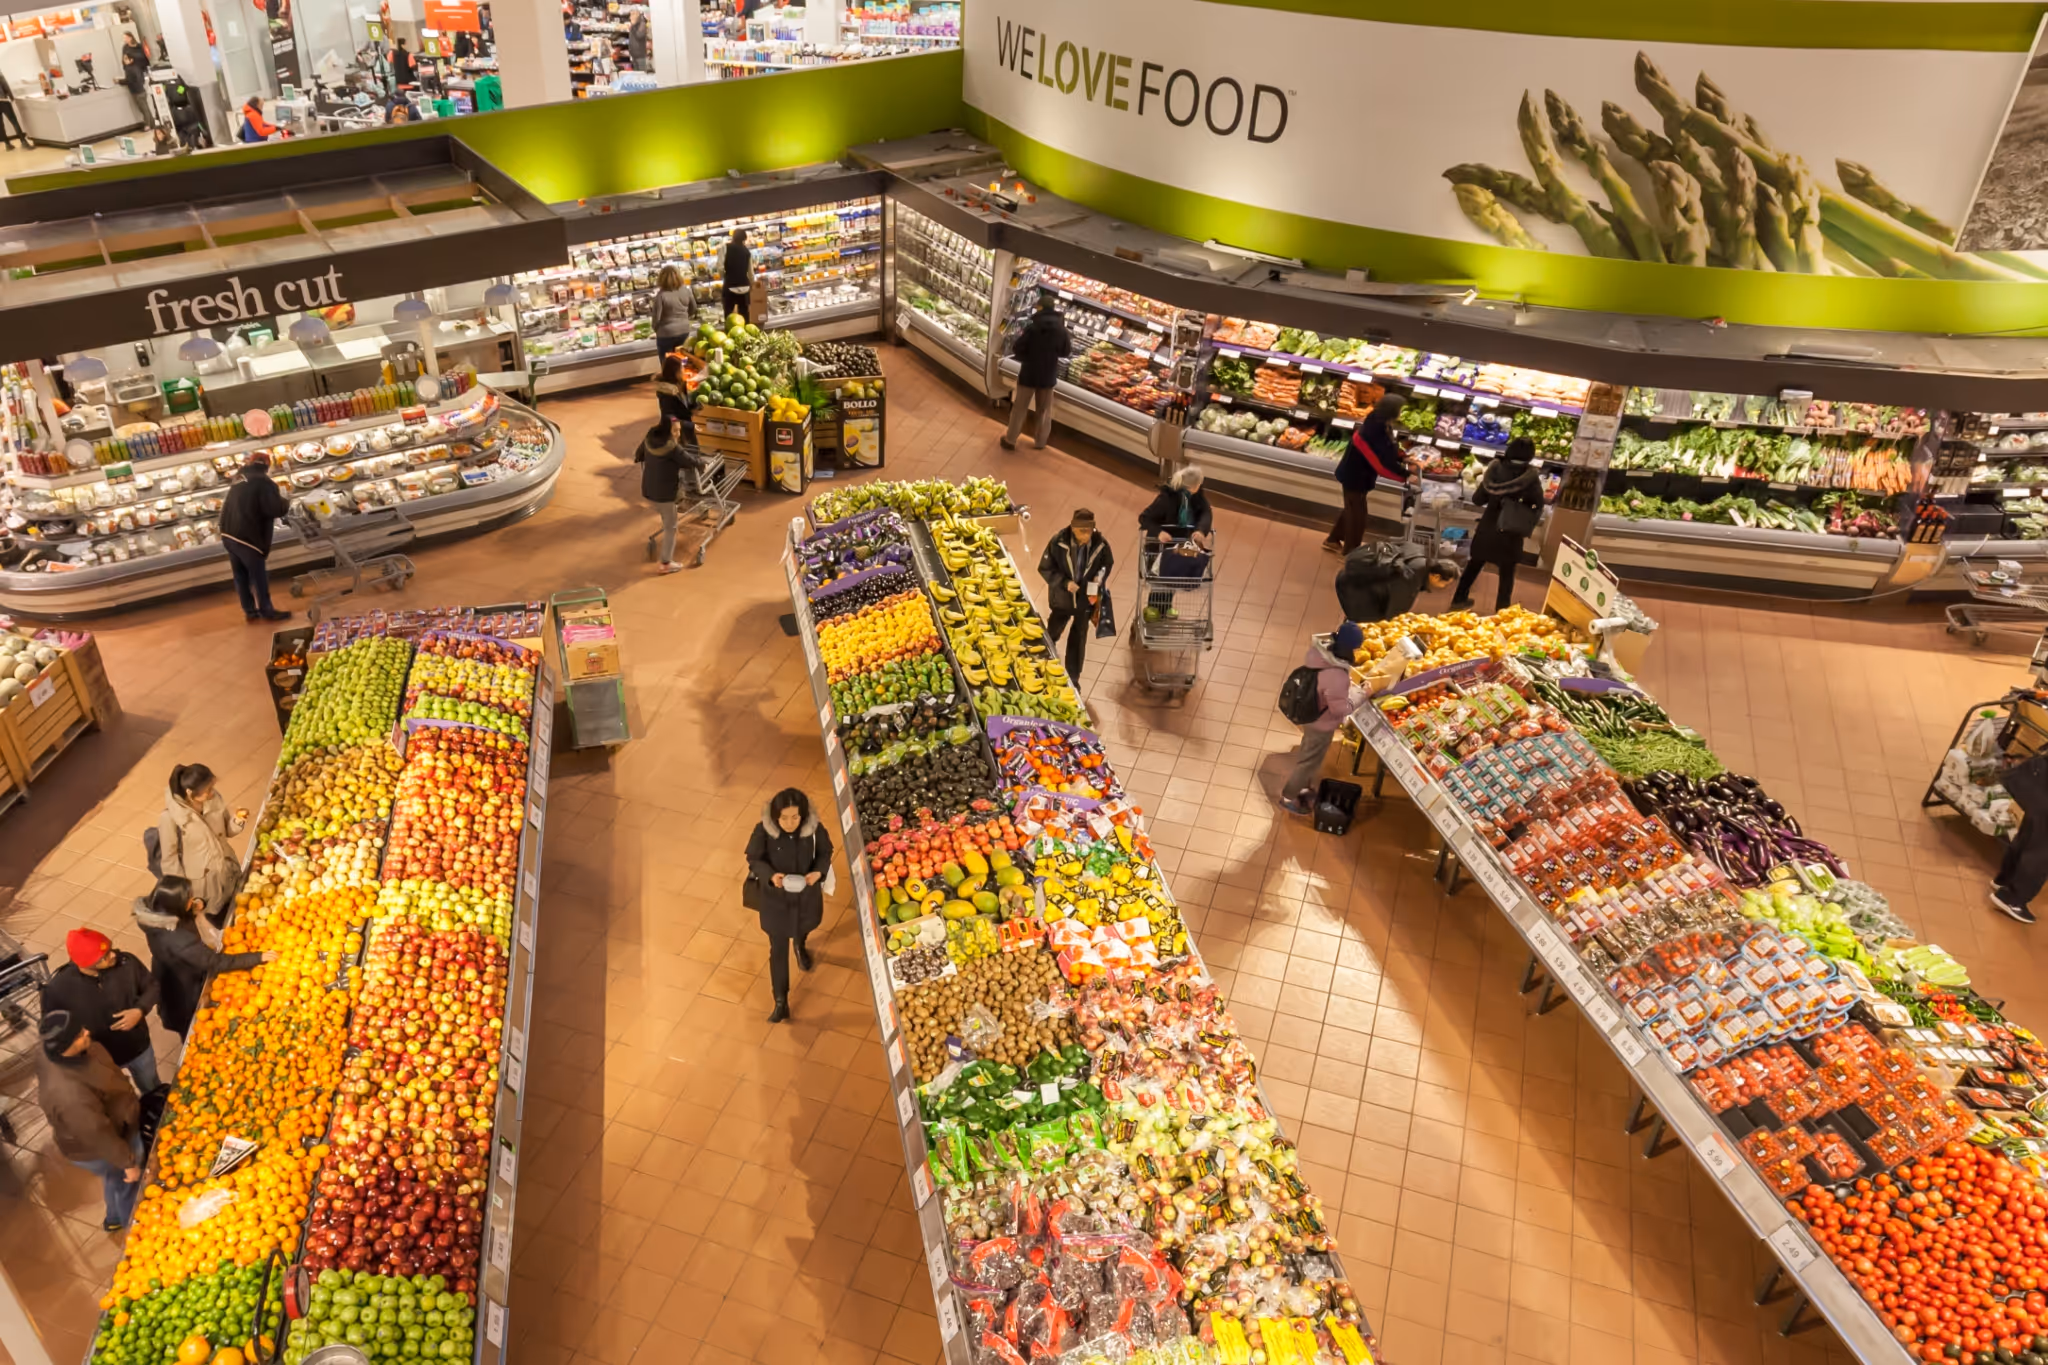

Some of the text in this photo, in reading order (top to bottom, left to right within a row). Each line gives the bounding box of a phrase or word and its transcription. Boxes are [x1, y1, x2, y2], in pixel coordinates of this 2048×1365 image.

[997, 16, 1035, 80] WE
[1038, 33, 1133, 112] LOVE
[1138, 61, 1288, 144] FOOD
[145, 264, 348, 335] fresh cut
[843, 400, 877, 409] BOLLO
[847, 511, 877, 525] Organic
[1439, 661, 1475, 675] Organic
[1781, 1239, 1800, 1259] 2.49
